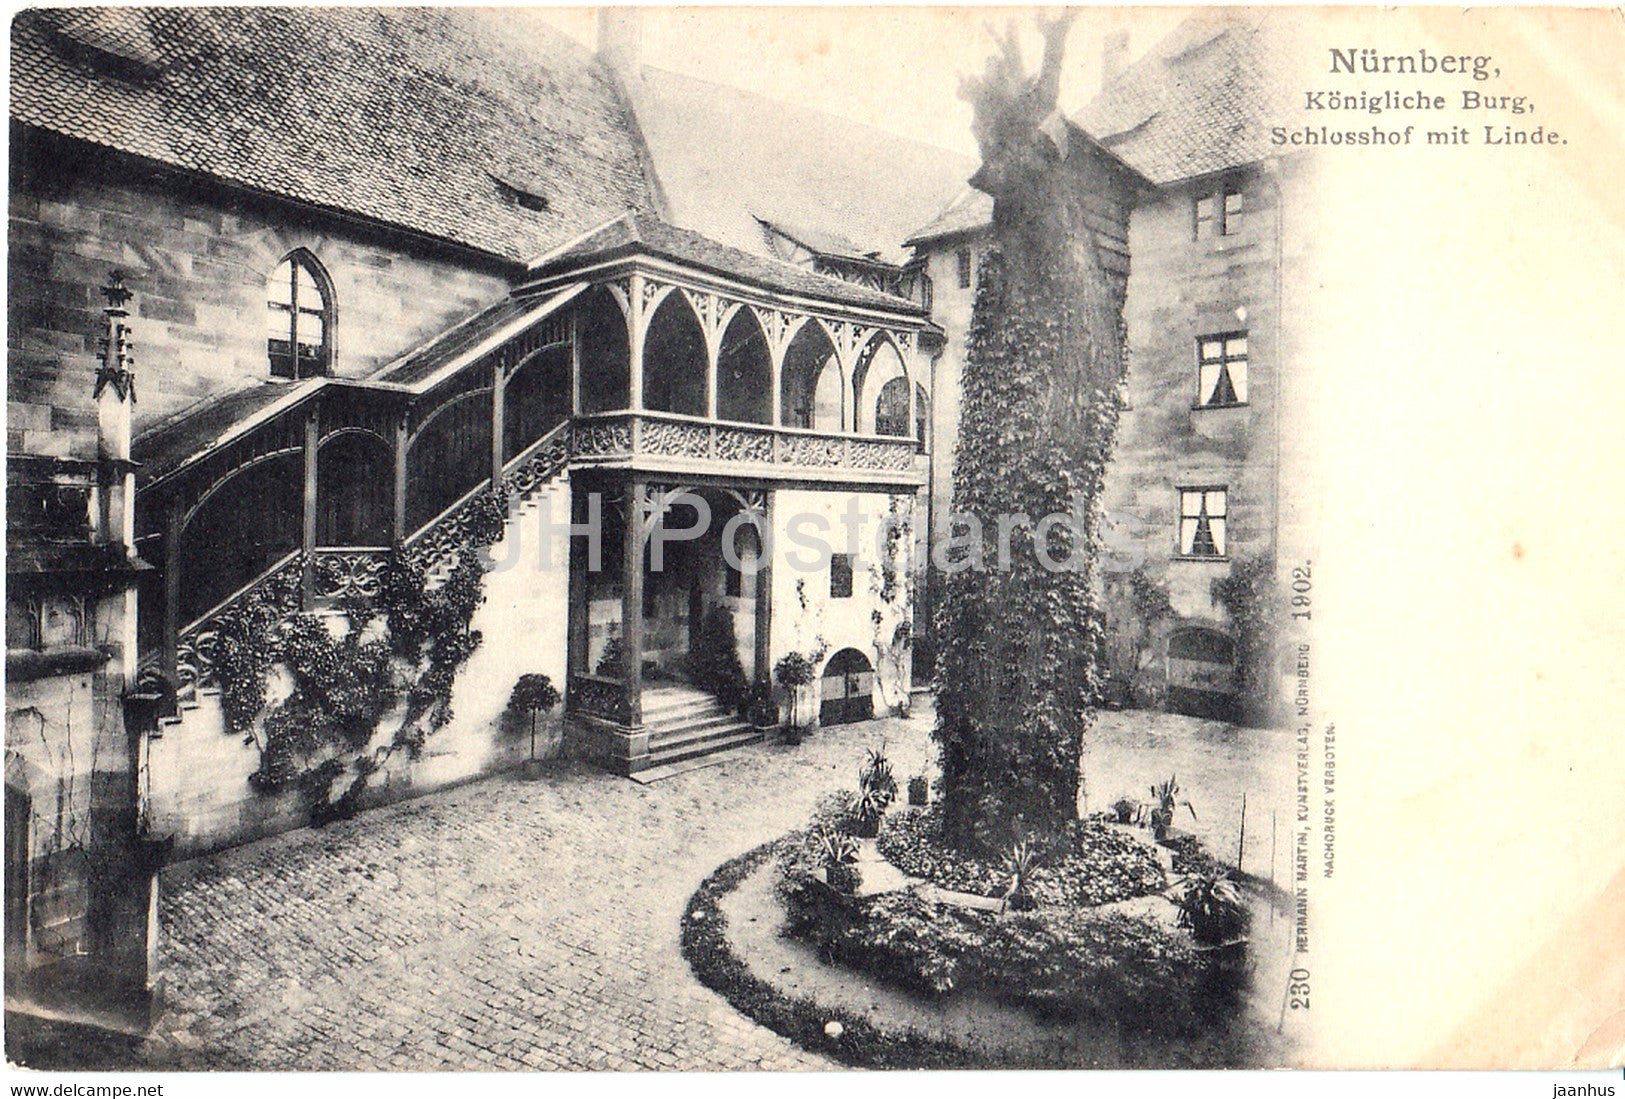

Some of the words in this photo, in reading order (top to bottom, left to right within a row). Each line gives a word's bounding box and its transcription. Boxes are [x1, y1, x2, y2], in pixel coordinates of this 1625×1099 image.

[1329, 48, 1501, 81] Nürnberg,
[1304, 90, 1446, 115] Königliche
[1462, 90, 1535, 115] Burg,
[1271, 125, 1415, 146] Schlosshof
[1427, 126, 1470, 145] mit
[1484, 126, 1568, 146] Linde.
[1291, 558, 1311, 621] 1902.
[1297, 723, 1312, 821] KUNSTVERLAG,
[1296, 826, 1312, 882] MARTIN,
[1296, 888, 1309, 953] HERMANN
[1290, 968, 1310, 1011] 230
